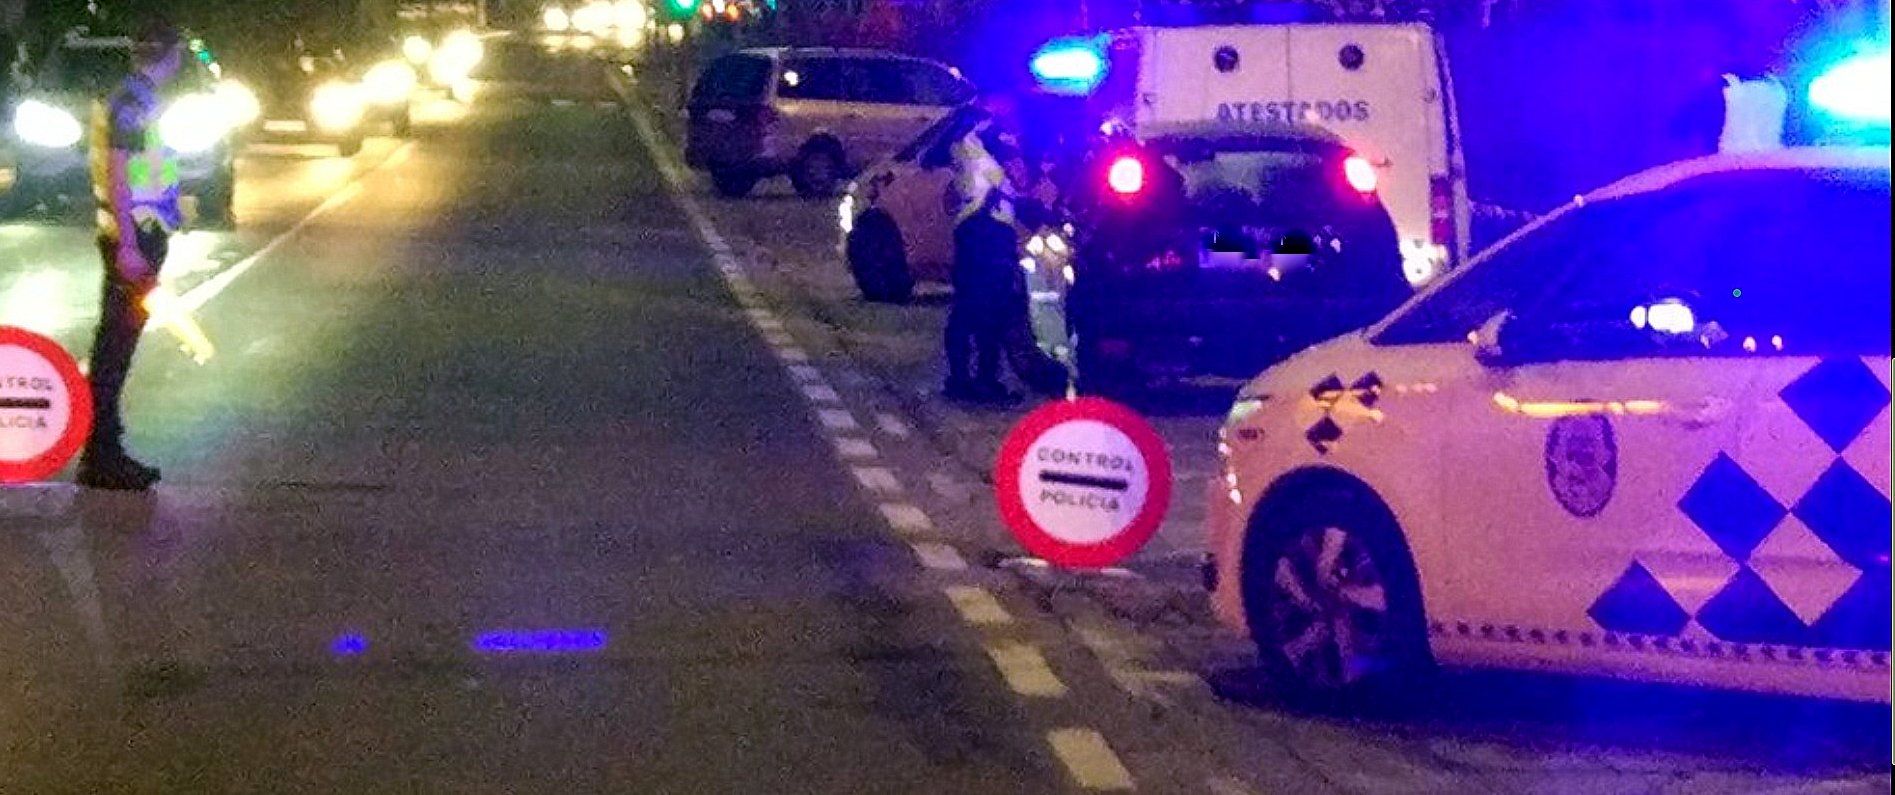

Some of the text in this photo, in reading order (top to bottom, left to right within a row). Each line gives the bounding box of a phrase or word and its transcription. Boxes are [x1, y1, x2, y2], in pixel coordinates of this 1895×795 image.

[0, 375, 53, 391] TROL
[1038, 447, 1135, 472] CONTROL
[1040, 488, 1120, 511] POLICIA
